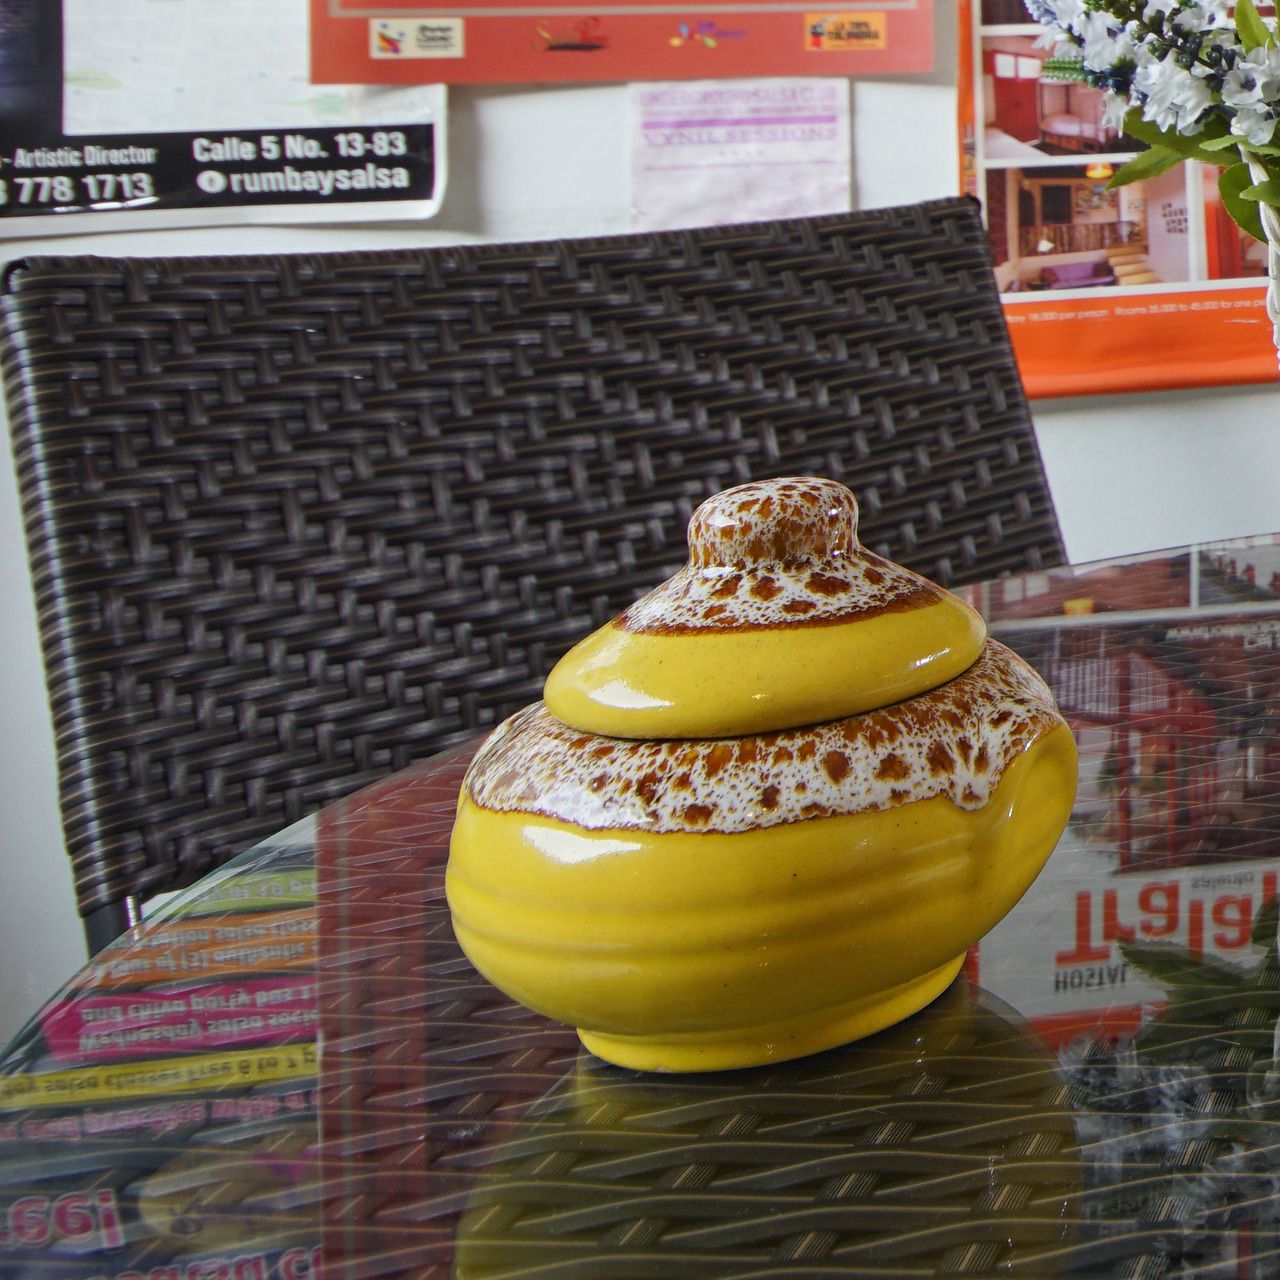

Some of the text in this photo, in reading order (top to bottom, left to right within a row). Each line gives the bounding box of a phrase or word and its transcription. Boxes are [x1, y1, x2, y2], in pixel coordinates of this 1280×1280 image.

[192, 130, 407, 162] Calle 5 No. 13-83
[229, 163, 409, 196] rumbaysalsa
